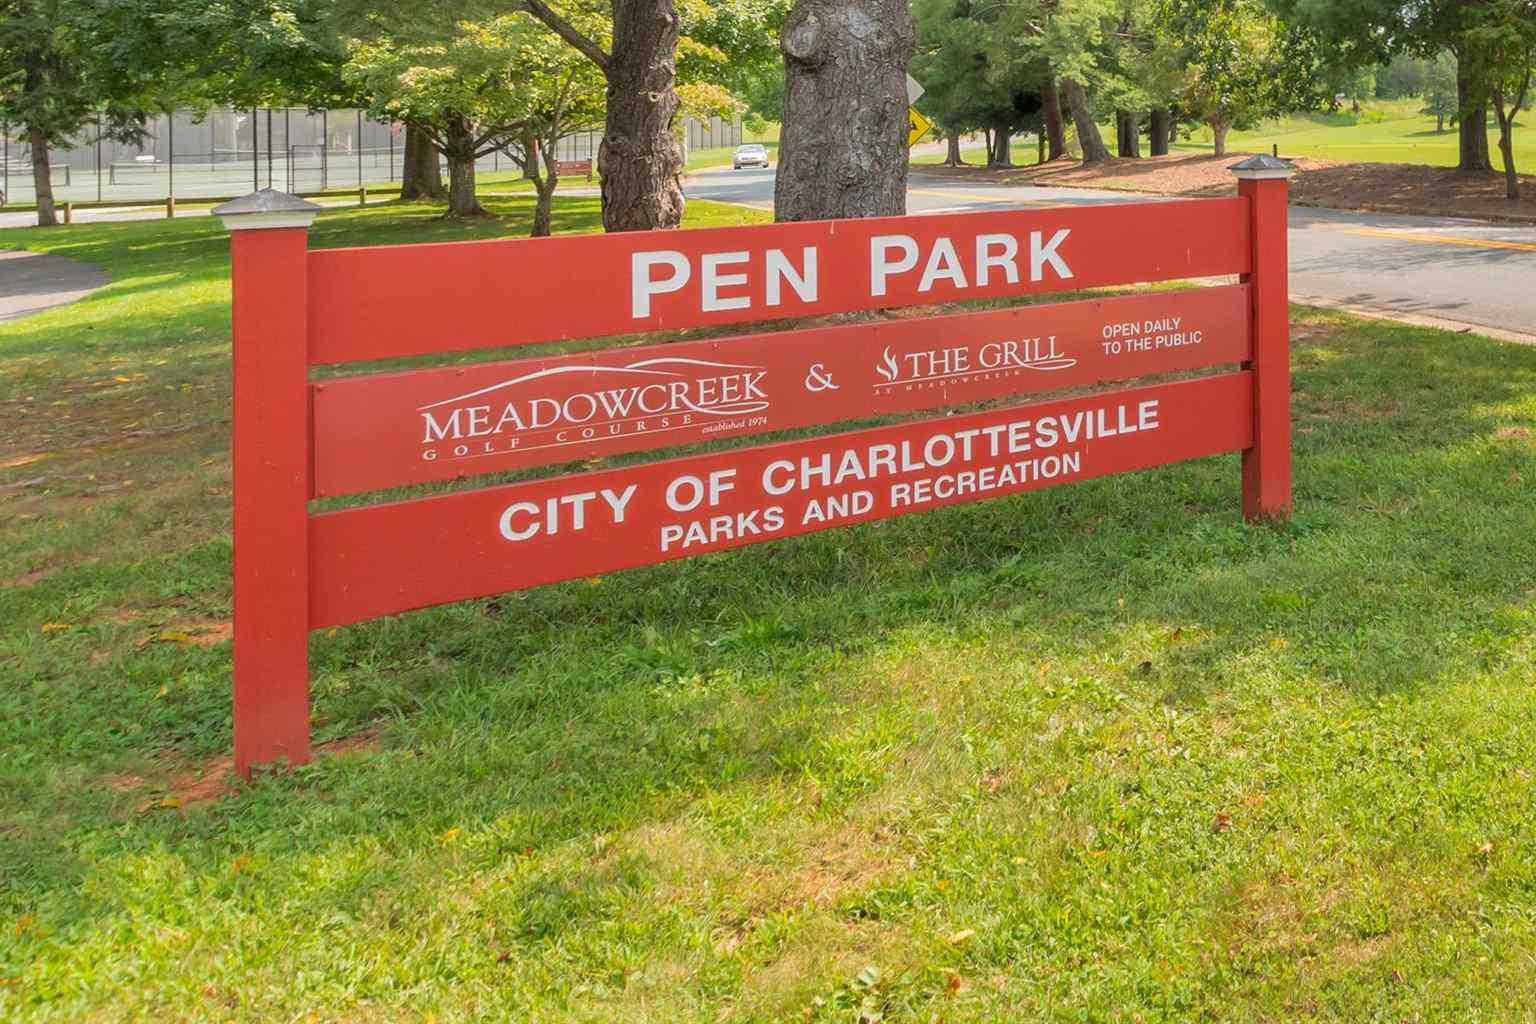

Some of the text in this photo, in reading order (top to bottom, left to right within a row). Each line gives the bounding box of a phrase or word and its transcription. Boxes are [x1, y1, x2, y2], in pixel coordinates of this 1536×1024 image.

[631, 228, 1074, 319] PEN PARK
[1102, 317, 1182, 339] OPEN DAILY
[1102, 330, 1203, 355] TO THE PUBLIC
[804, 363, 840, 392] &
[904, 336, 1067, 379] THE GRILL
[420, 371, 770, 444] MEADOWCREEK
[873, 386, 894, 397] AT
[422, 413, 693, 462] GOLF COURSE
[701, 415, 768, 434] established 1974
[499, 399, 1161, 543] CITY OF CHARLOTTESVILLE
[660, 451, 1081, 553] PARKS AND RECREATION
